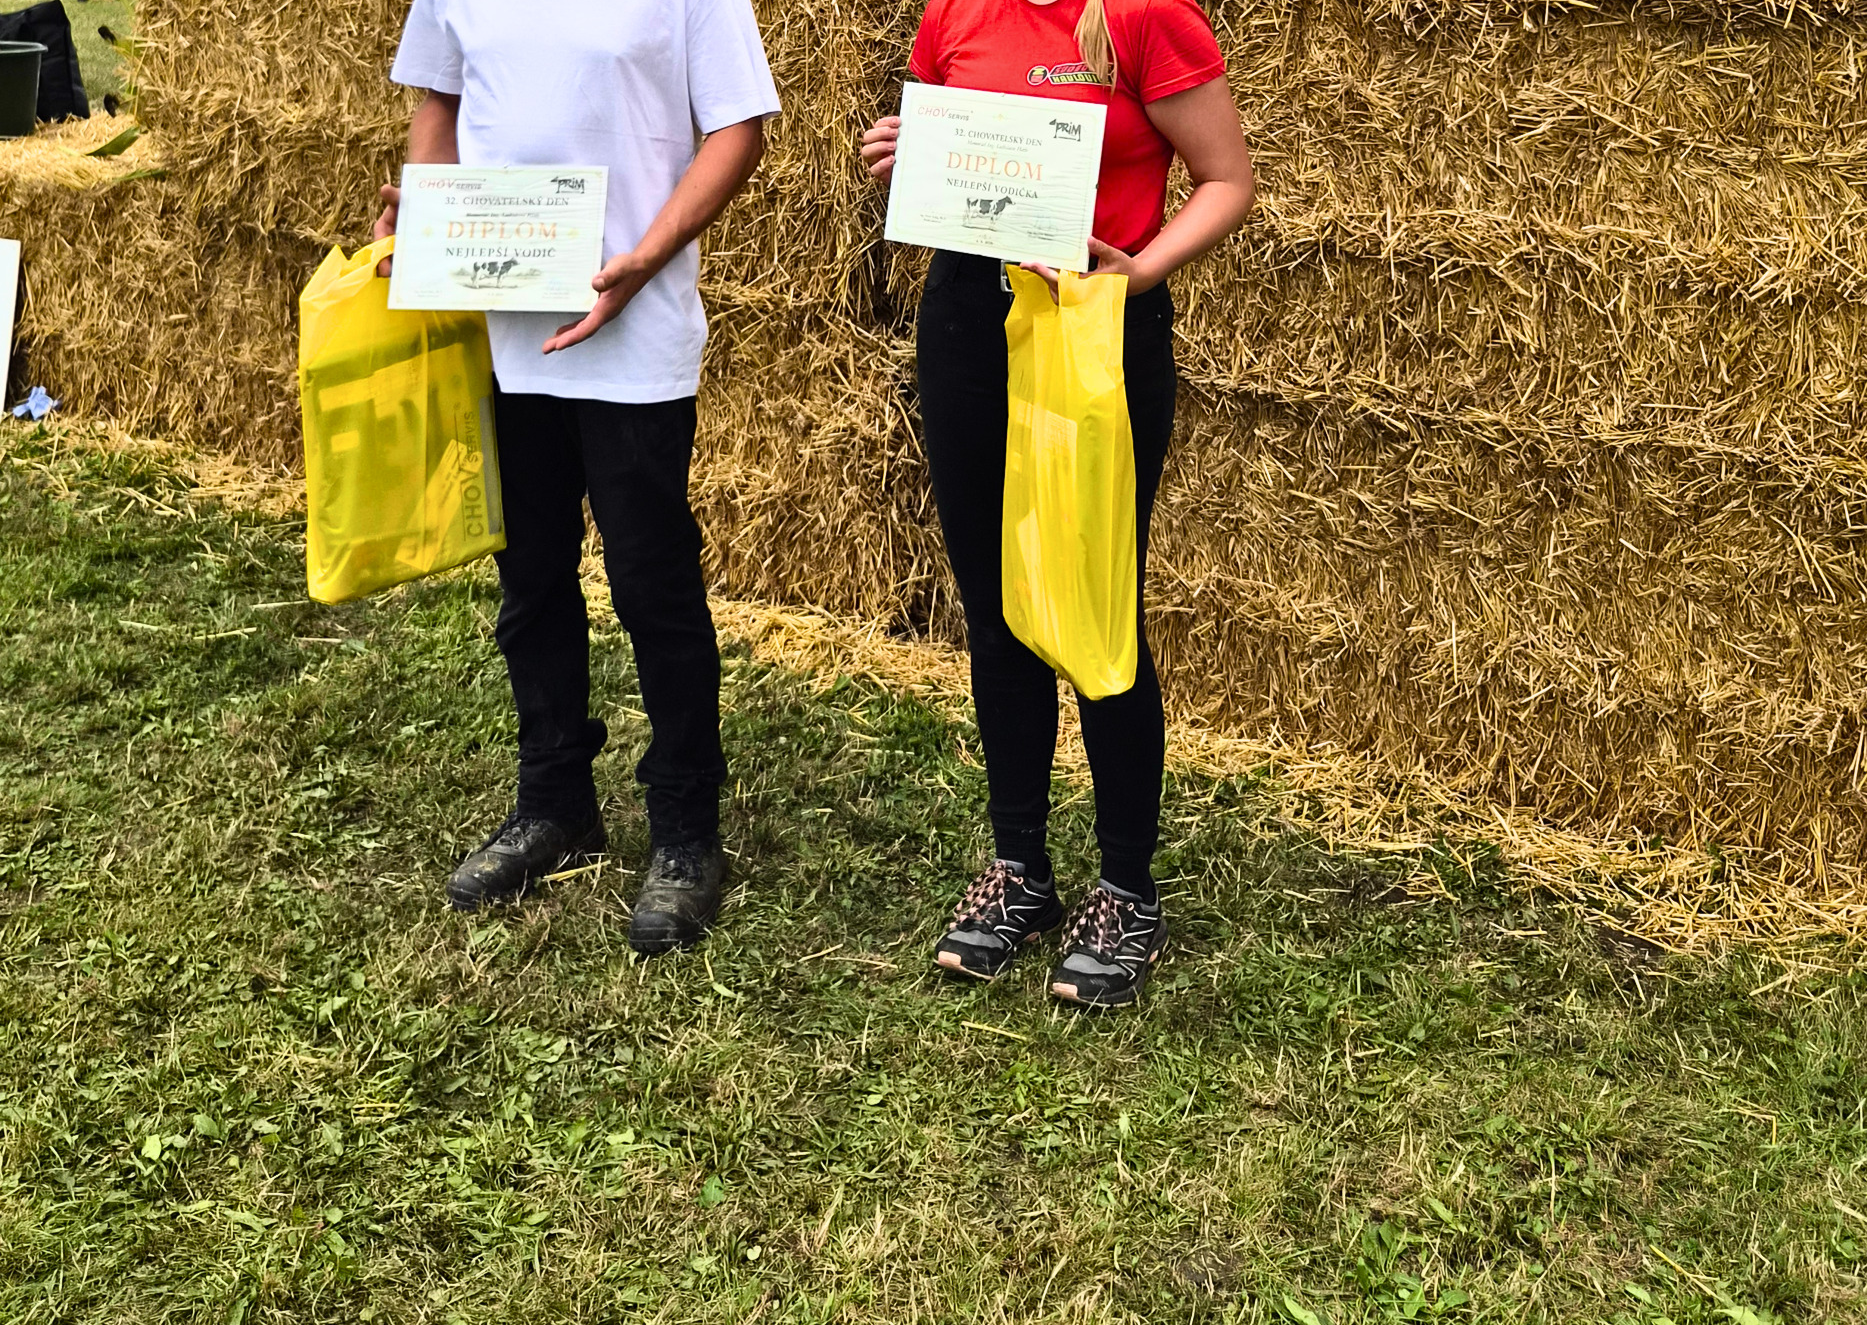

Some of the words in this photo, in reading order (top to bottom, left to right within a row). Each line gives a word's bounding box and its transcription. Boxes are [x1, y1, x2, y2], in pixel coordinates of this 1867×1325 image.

[954, 128, 966, 137] 32.
[968, 130, 1025, 145] CHOVATELSKÝ
[1025, 137, 1042, 147] DEN
[946, 151, 1043, 181] DIPLOM
[946, 178, 992, 192] NEJLEPŠÍ
[994, 185, 1039, 199] VODIČKA
[444, 197, 458, 205] 32.
[463, 196, 542, 206] CHOVATELSKÝ
[546, 197, 569, 206] DEN
[447, 221, 557, 240] DIPLOM
[445, 247, 508, 258] NEJLEPŠÍ
[514, 247, 557, 258] VODIČ
